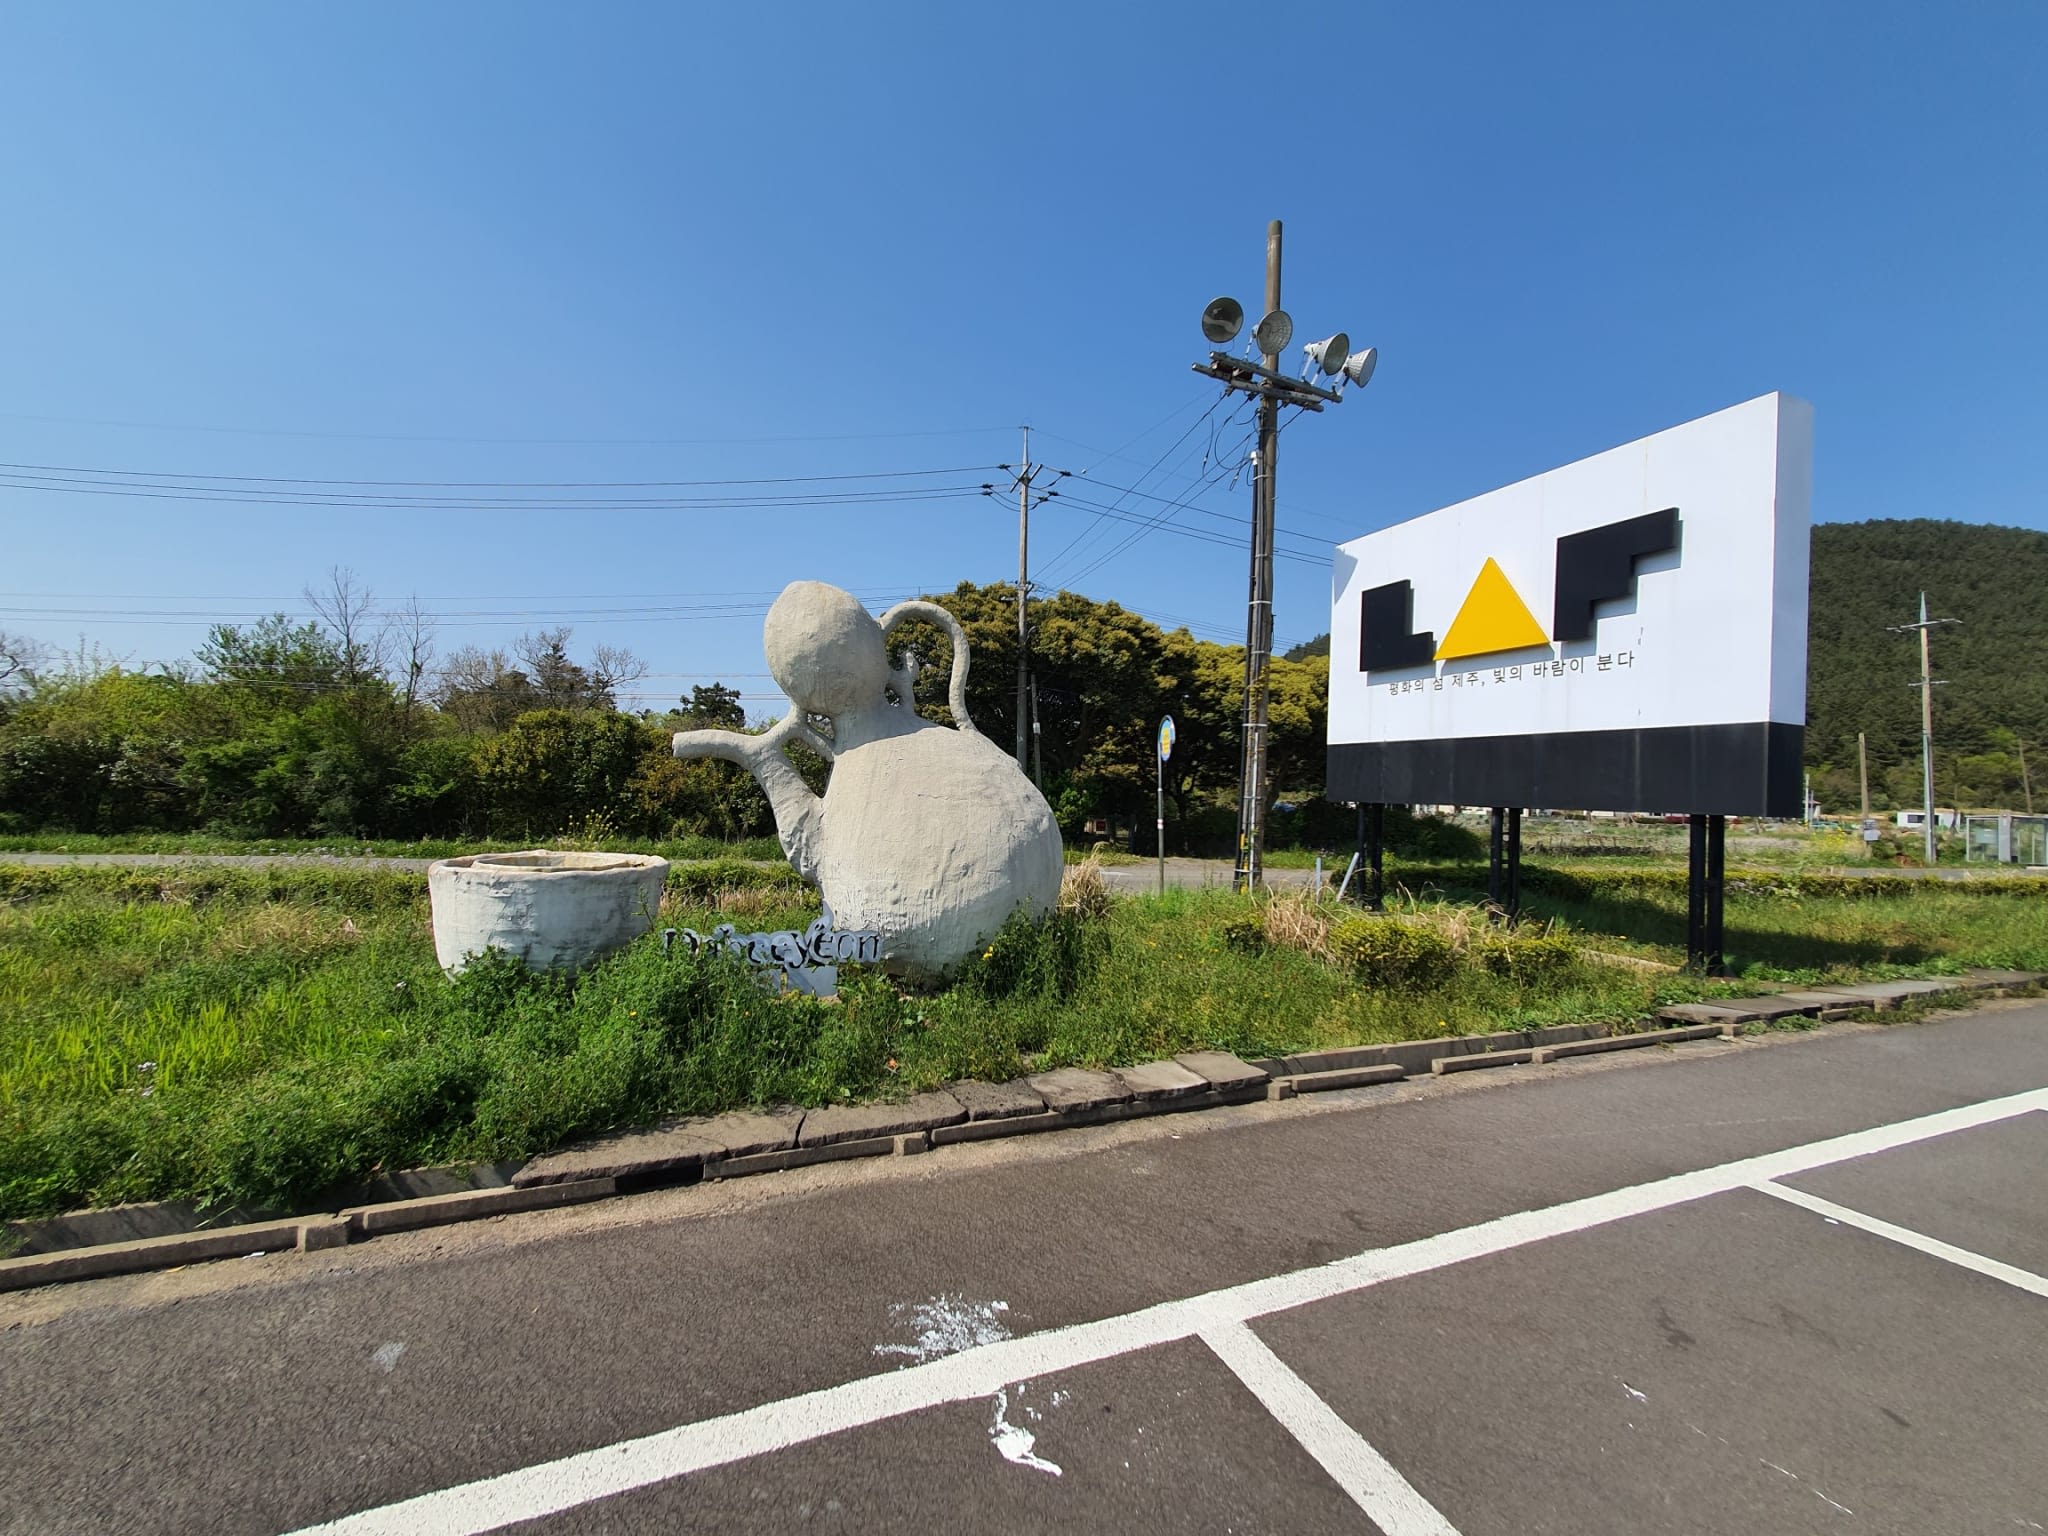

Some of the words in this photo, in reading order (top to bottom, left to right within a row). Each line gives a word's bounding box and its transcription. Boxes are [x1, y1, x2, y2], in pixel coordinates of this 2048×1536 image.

[1389, 679, 1425, 696] 평화의
[1432, 676, 1444, 691] 섬
[1452, 672, 1485, 688] 제주,
[1493, 664, 1523, 684] 빛의
[1533, 657, 1584, 678] 바람이
[1596, 650, 1635, 672] 분다
